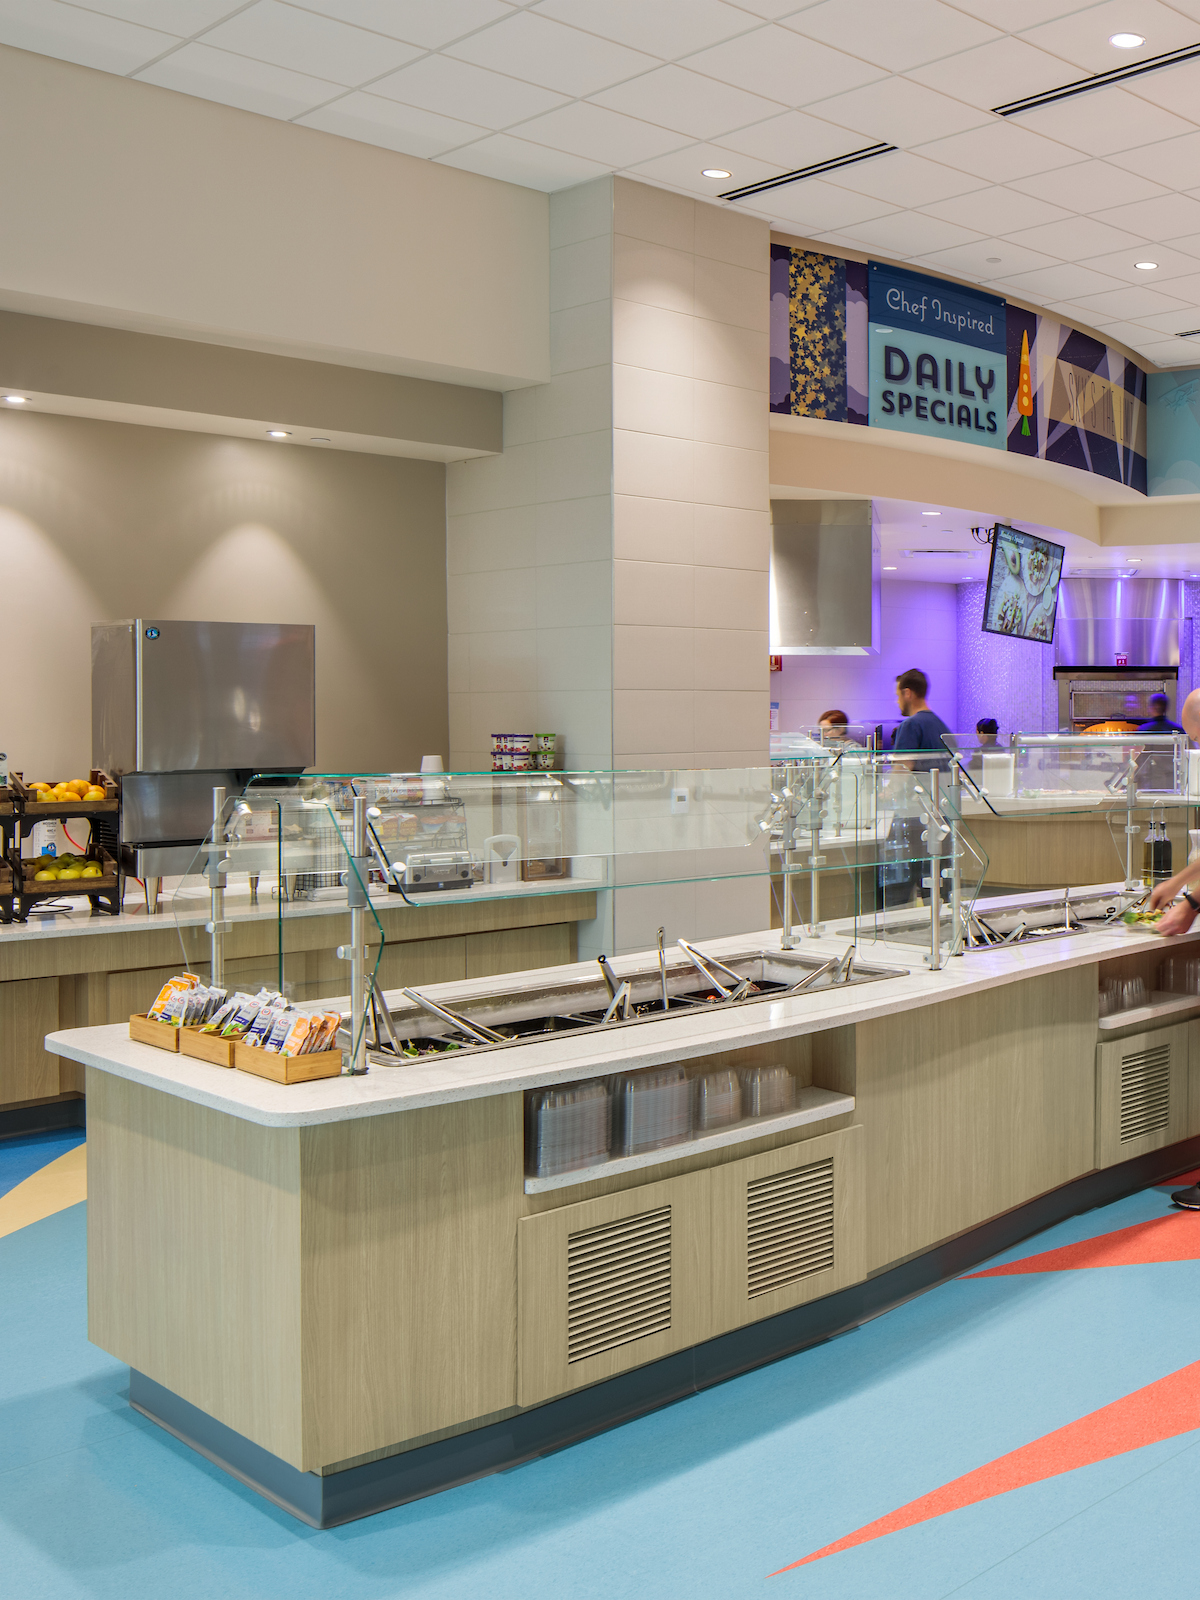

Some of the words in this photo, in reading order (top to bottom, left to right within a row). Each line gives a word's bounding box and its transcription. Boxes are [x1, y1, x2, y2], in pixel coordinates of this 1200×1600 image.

[886, 287, 928, 322] Chef
[932, 299, 994, 336] Inspired
[884, 345, 995, 400] DAILY
[881, 390, 998, 433] SPECIALS
